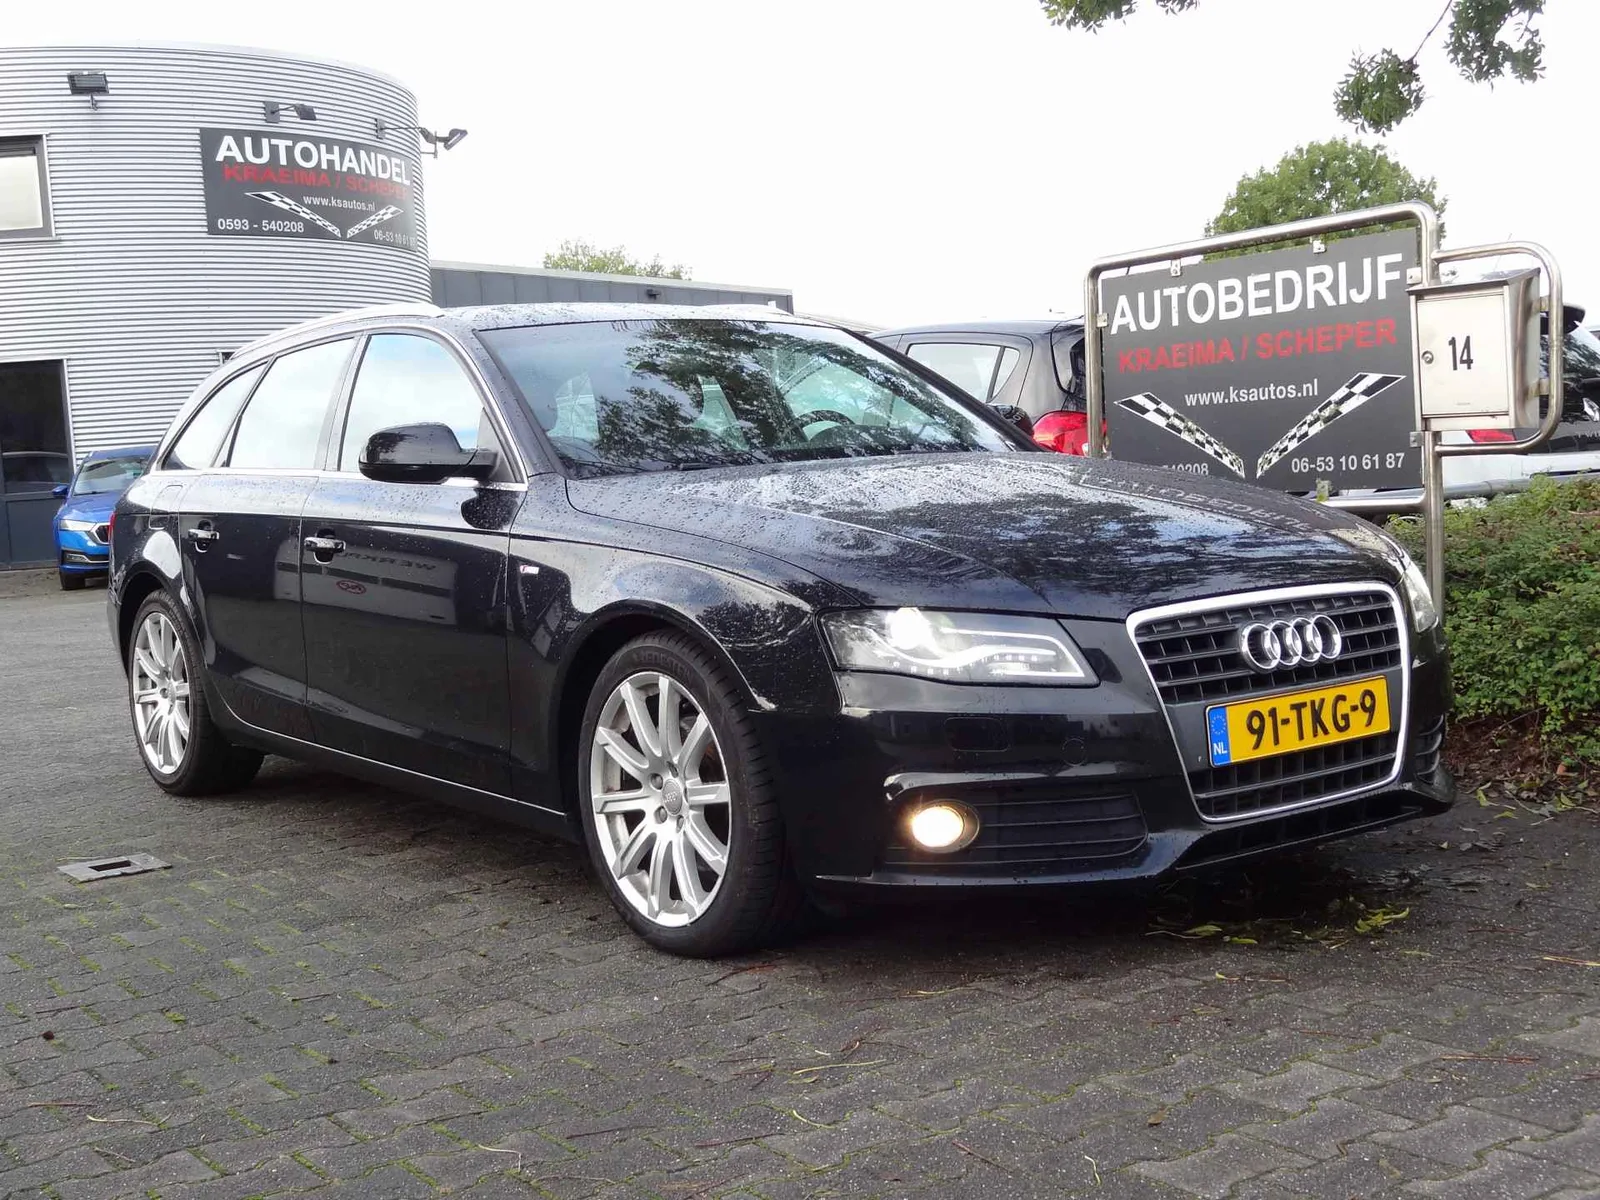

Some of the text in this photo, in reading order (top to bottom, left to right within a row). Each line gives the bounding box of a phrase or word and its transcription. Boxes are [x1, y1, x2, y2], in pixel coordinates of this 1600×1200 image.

[215, 135, 411, 186] AUTOHANDEL
[222, 163, 331, 188] KRAEIMA
[303, 195, 375, 212] www.ksautos.nl
[217, 218, 250, 231] 0593
[262, 219, 304, 233] 540208
[1110, 253, 1403, 335] AUTOBEDRIJF
[1118, 337, 1235, 374] KRAEIMA
[1256, 318, 1397, 360] SCHEPER
[1448, 335, 1474, 371] 14
[1185, 379, 1318, 407] www.ksautos.nl
[1163, 463, 1209, 476] 0208
[1291, 452, 1405, 473] 06-53 10 61 87
[1246, 689, 1377, 750] 91-TKG-9
[1213, 742, 1228, 756] NL
